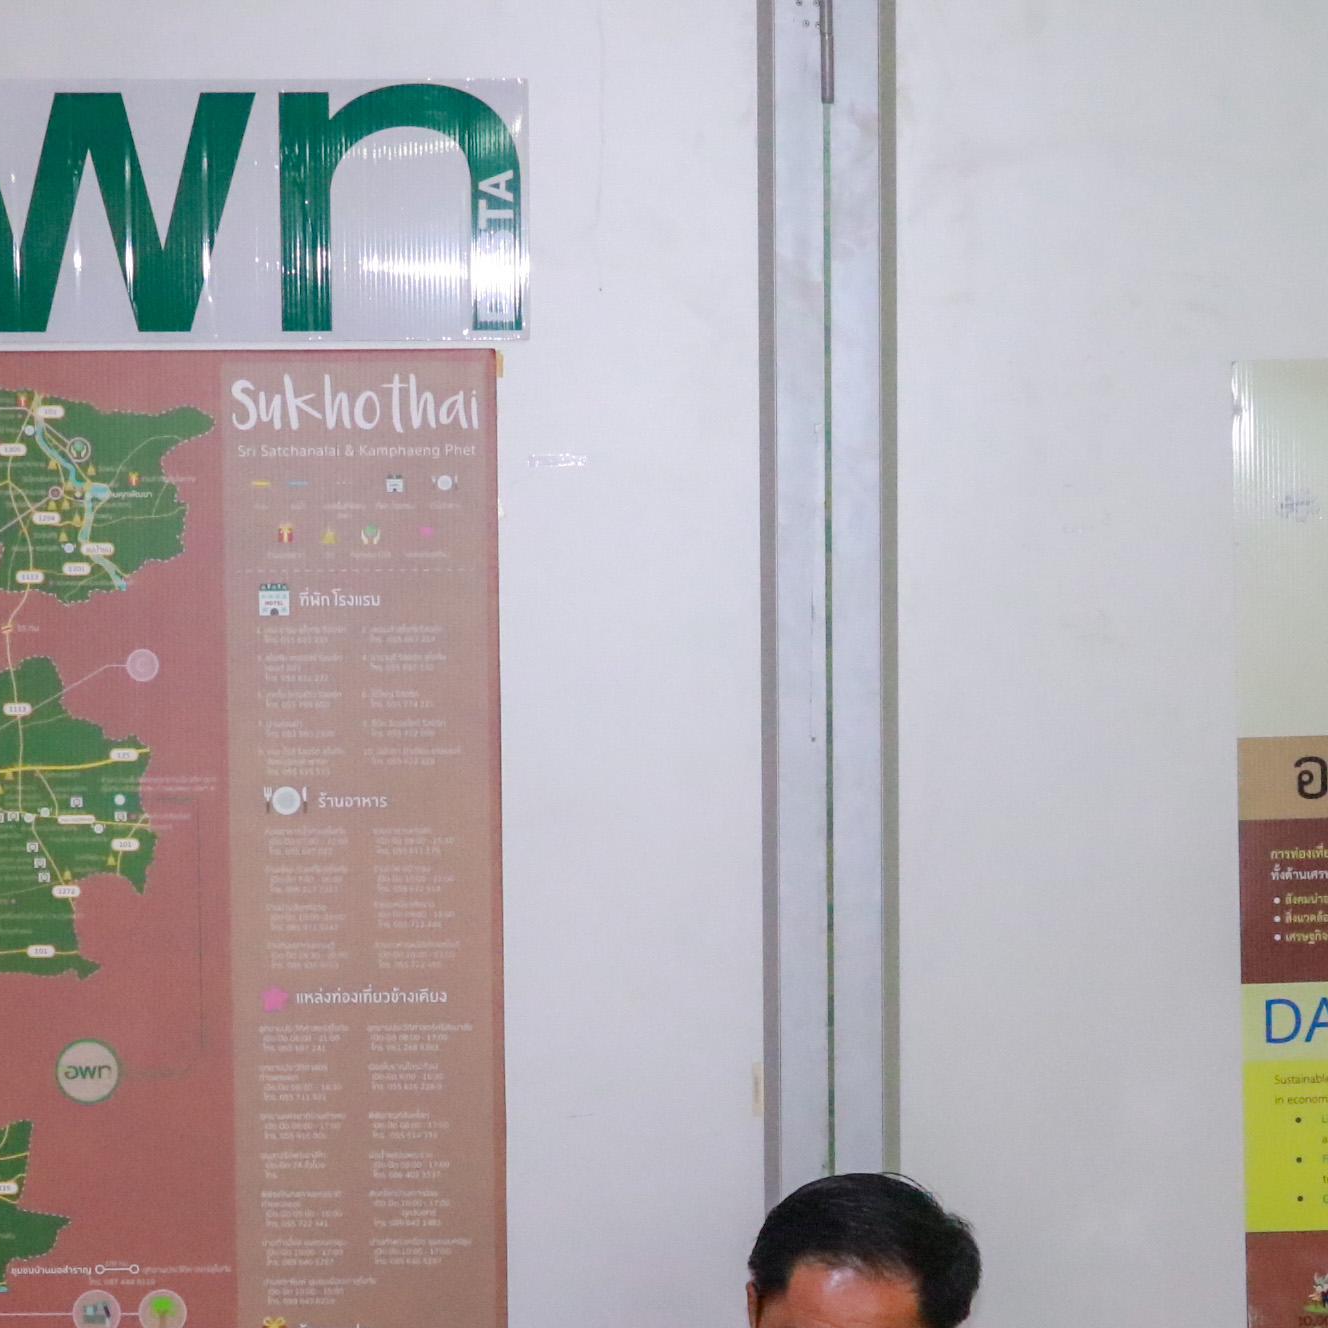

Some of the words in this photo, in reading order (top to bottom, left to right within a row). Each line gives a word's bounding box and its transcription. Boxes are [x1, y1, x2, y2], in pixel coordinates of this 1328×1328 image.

[478, 170, 515, 321] DTA
[231, 373, 479, 433] Sukhothai
[238, 445, 256, 457] Sri
[260, 444, 340, 458] Satchanalai
[345, 445, 355, 457] &
[359, 445, 441, 459] Kamphaeng
[445, 443, 477, 457] Phet
[332, 588, 381, 607] โรงแรม
[317, 792, 388, 809] ร้านอาหาร
[296, 987, 448, 1006] แหล่งท่องเที่ยวข้างเคียง
